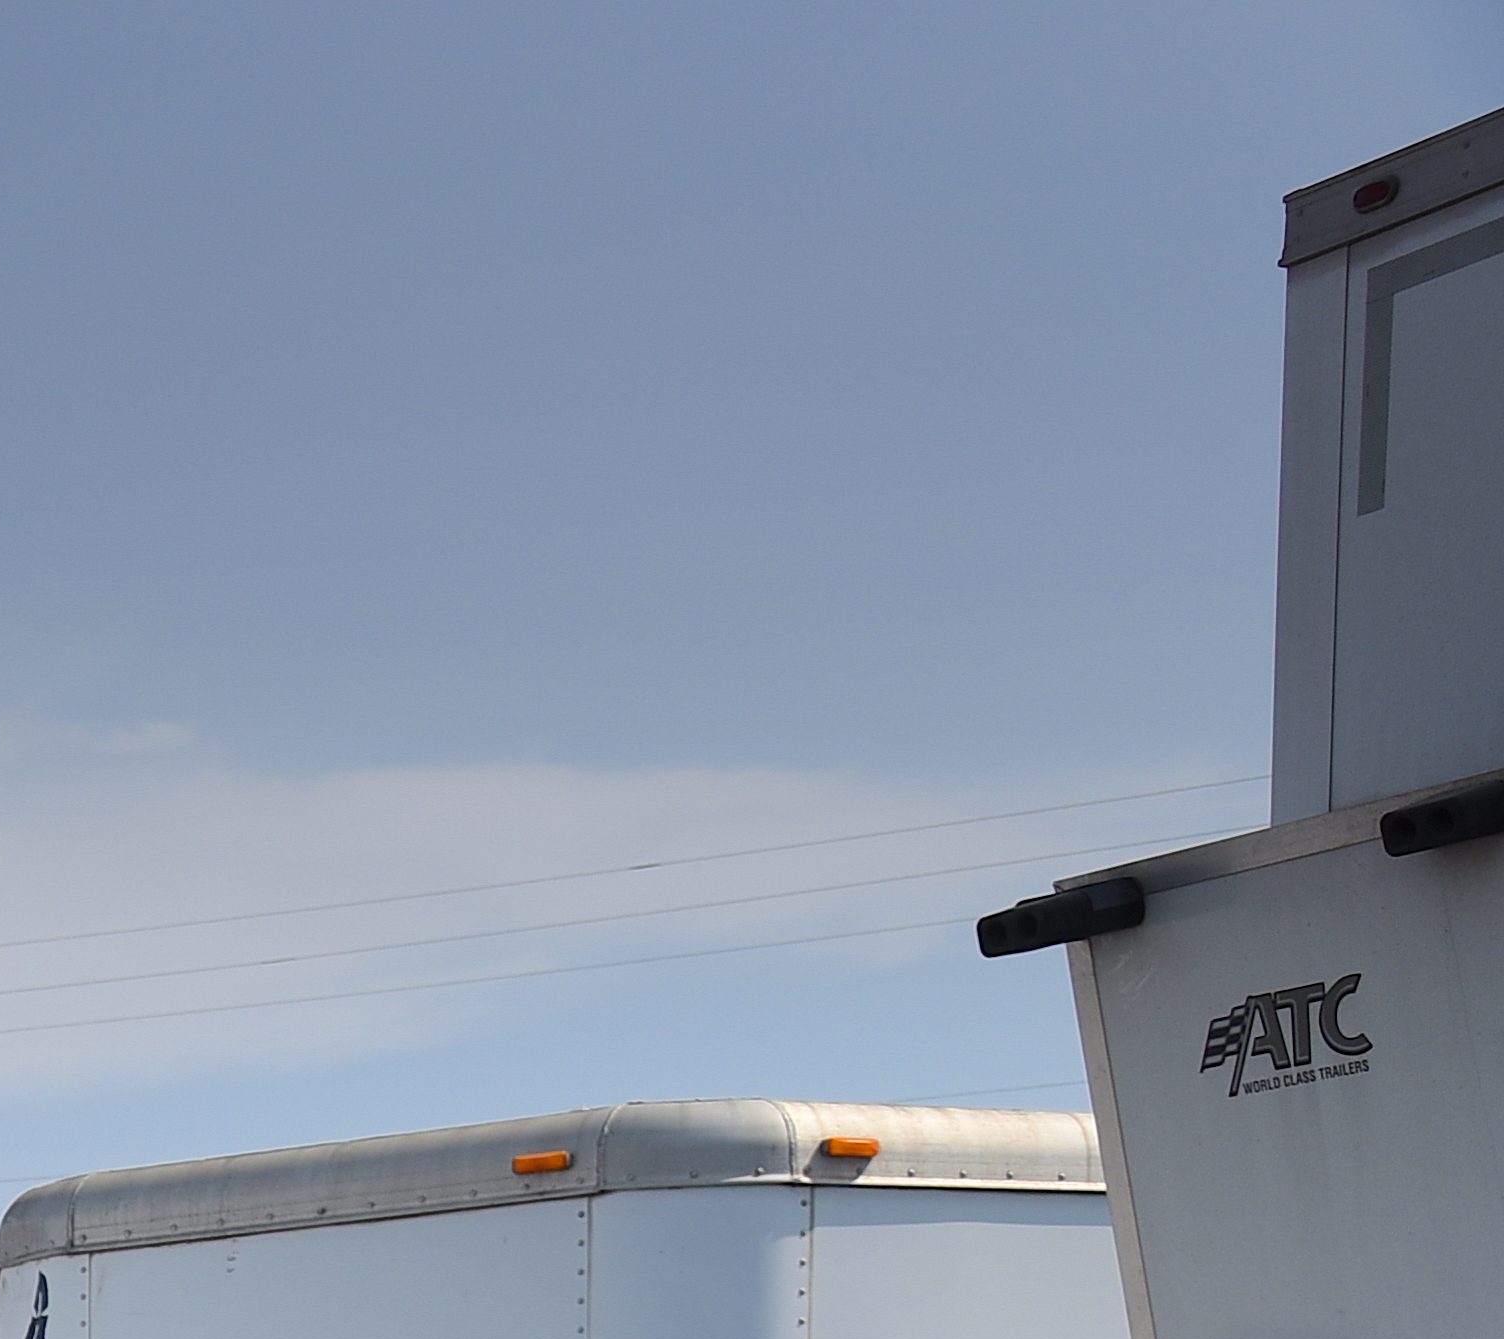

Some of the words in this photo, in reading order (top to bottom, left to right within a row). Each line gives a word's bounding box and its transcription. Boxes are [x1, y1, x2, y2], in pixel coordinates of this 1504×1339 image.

[1231, 973, 1373, 1080] ATC
[1243, 1076, 1281, 1095] WORLD
[1284, 1070, 1316, 1087] CLASS
[1318, 1059, 1370, 1080] TRAILERS
